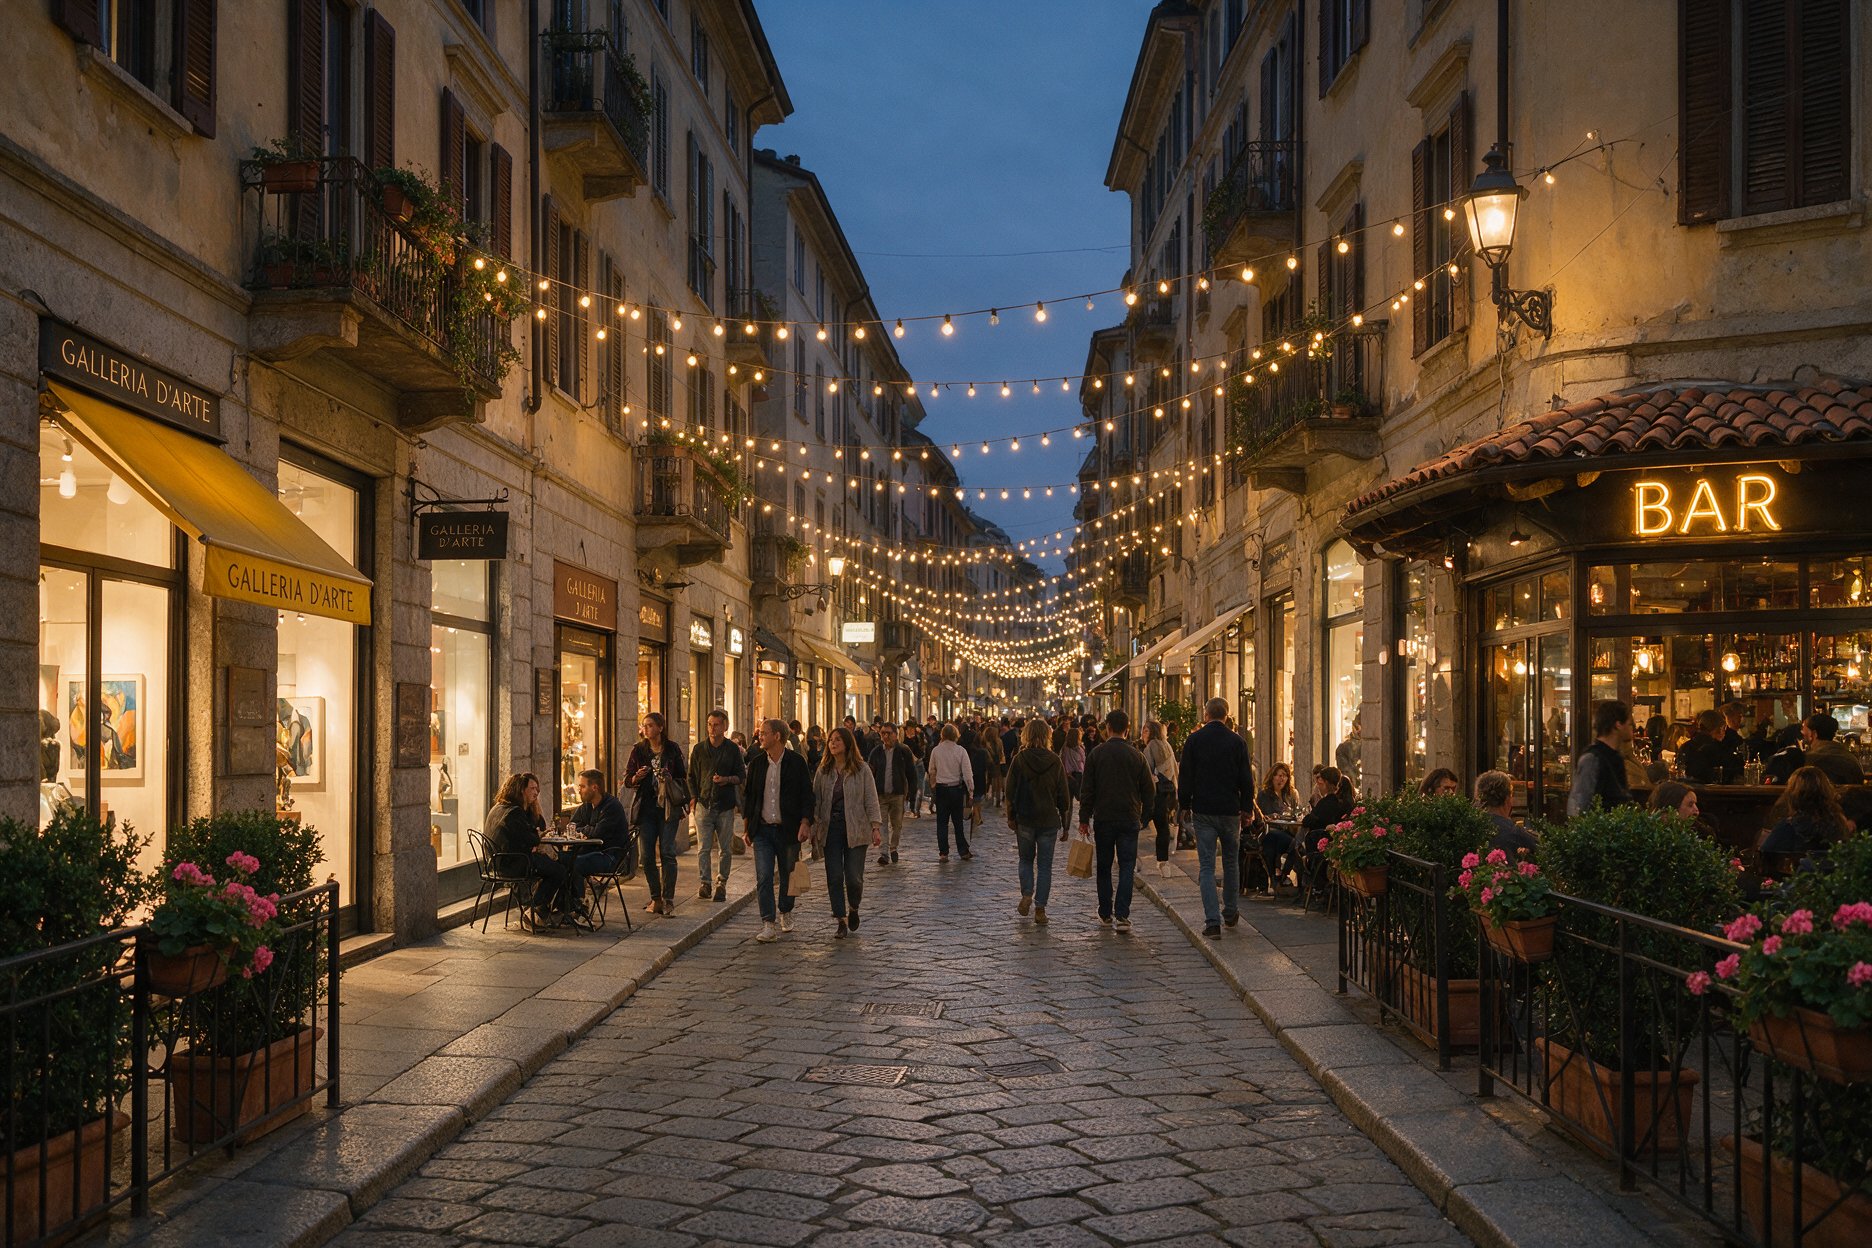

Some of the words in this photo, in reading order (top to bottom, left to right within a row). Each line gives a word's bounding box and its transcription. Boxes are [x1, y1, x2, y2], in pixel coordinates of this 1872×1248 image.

[61, 338, 148, 398] GALLERIA
[156, 379, 211, 424] D'ARTE
[1633, 474, 1782, 536] BAR
[430, 524, 495, 536] GALLERIA
[439, 536, 485, 548] D'ARTE
[227, 563, 304, 601] GALLERIA
[310, 582, 355, 613] D'ARTE
[566, 577, 606, 604] GALLERIA
